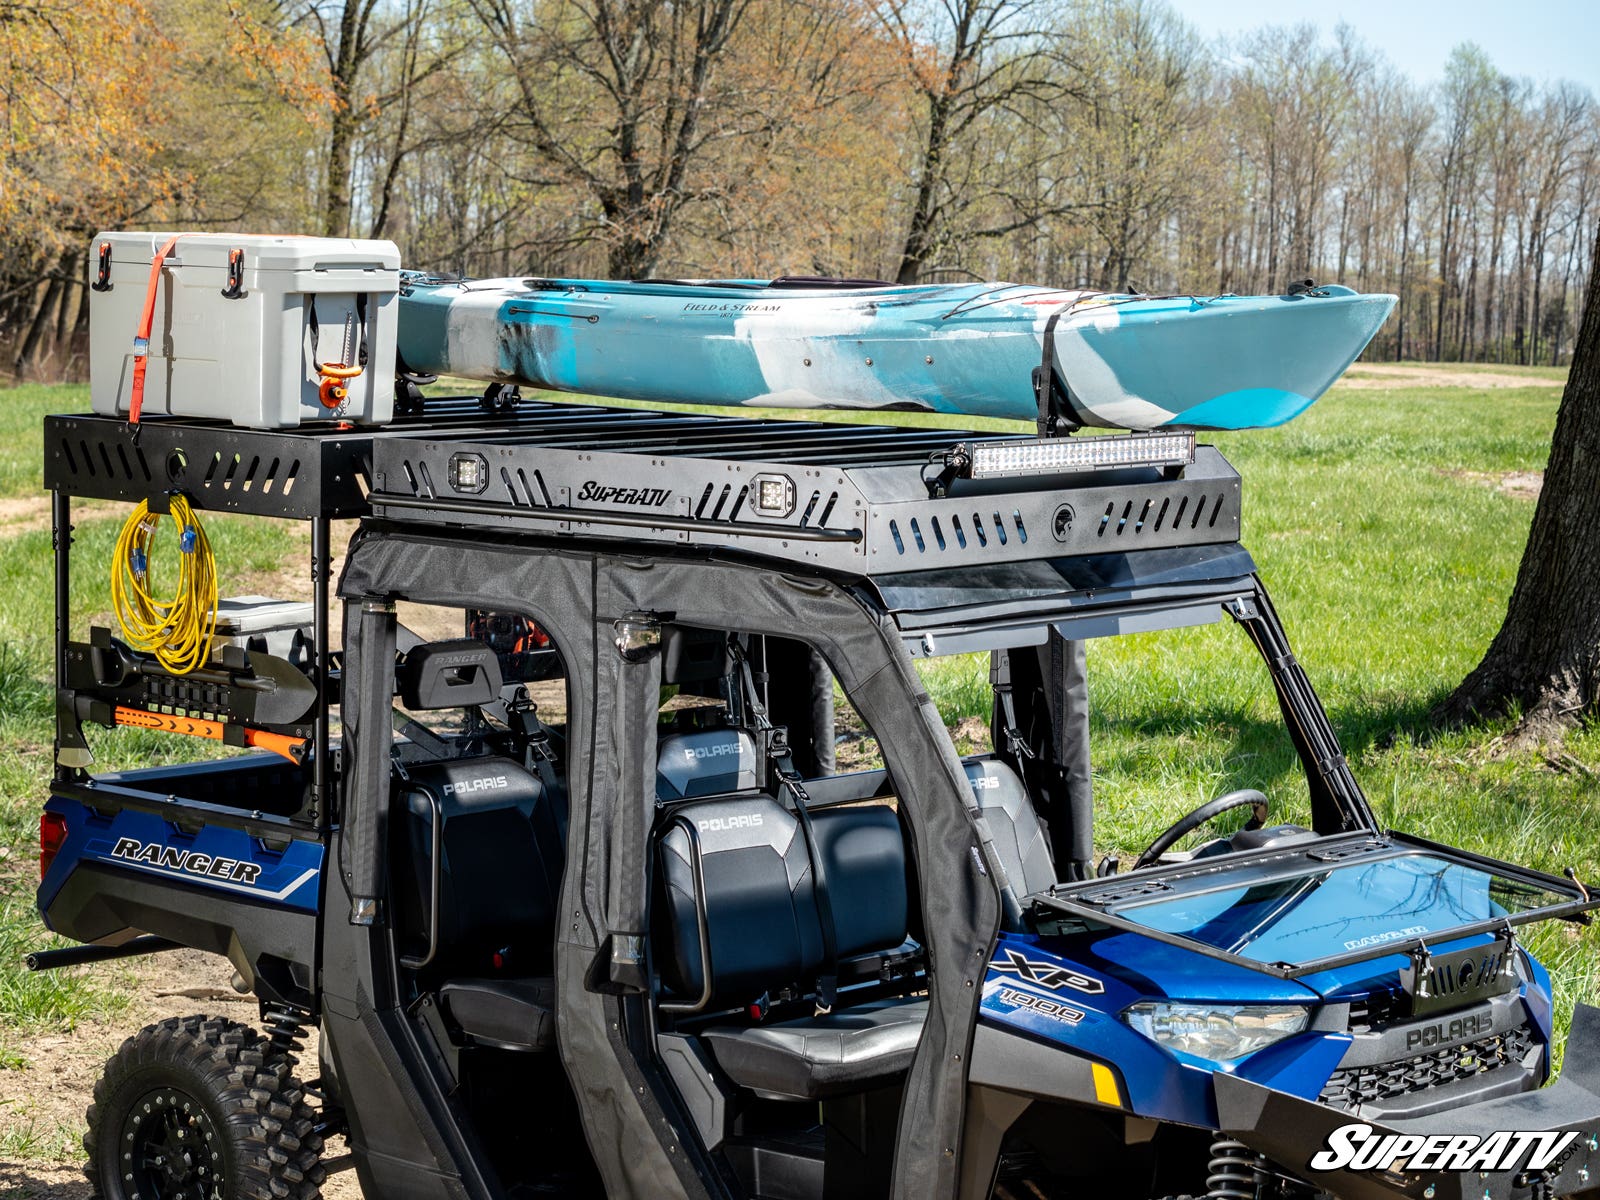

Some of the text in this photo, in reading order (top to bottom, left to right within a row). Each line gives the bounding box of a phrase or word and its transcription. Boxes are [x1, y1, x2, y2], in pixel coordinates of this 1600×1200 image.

[683, 303, 718, 311] FIELD
[731, 304, 781, 312] STREAM
[577, 481, 672, 506] SUPERATV
[434, 653, 488, 665] RANGER
[684, 743, 744, 760] POLARIS
[443, 776, 508, 796] POLARIS
[970, 777, 1000, 789] ARIS
[698, 813, 763, 833] POLARIS
[111, 837, 262, 885] RANGER
[987, 948, 1105, 994] XP
[1000, 988, 1085, 1023] 1000
[1407, 1011, 1493, 1051] POLARIS
